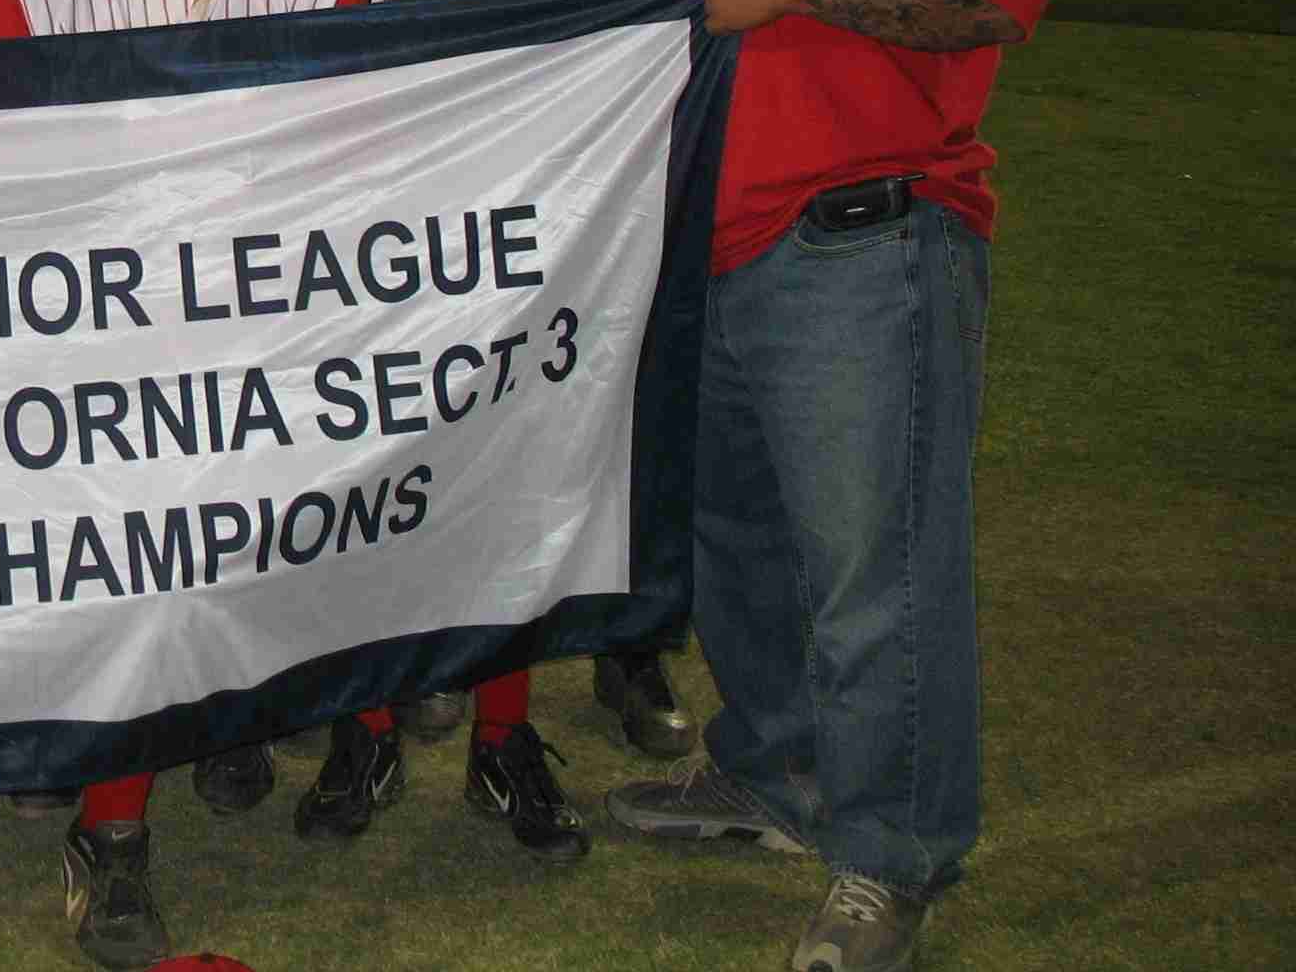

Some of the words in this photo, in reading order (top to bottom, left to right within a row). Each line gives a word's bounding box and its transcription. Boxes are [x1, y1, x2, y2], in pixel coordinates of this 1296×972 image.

[179, 204, 544, 323] LEAGUE
[315, 331, 529, 441] SECT.
[540, 306, 579, 383] 3
